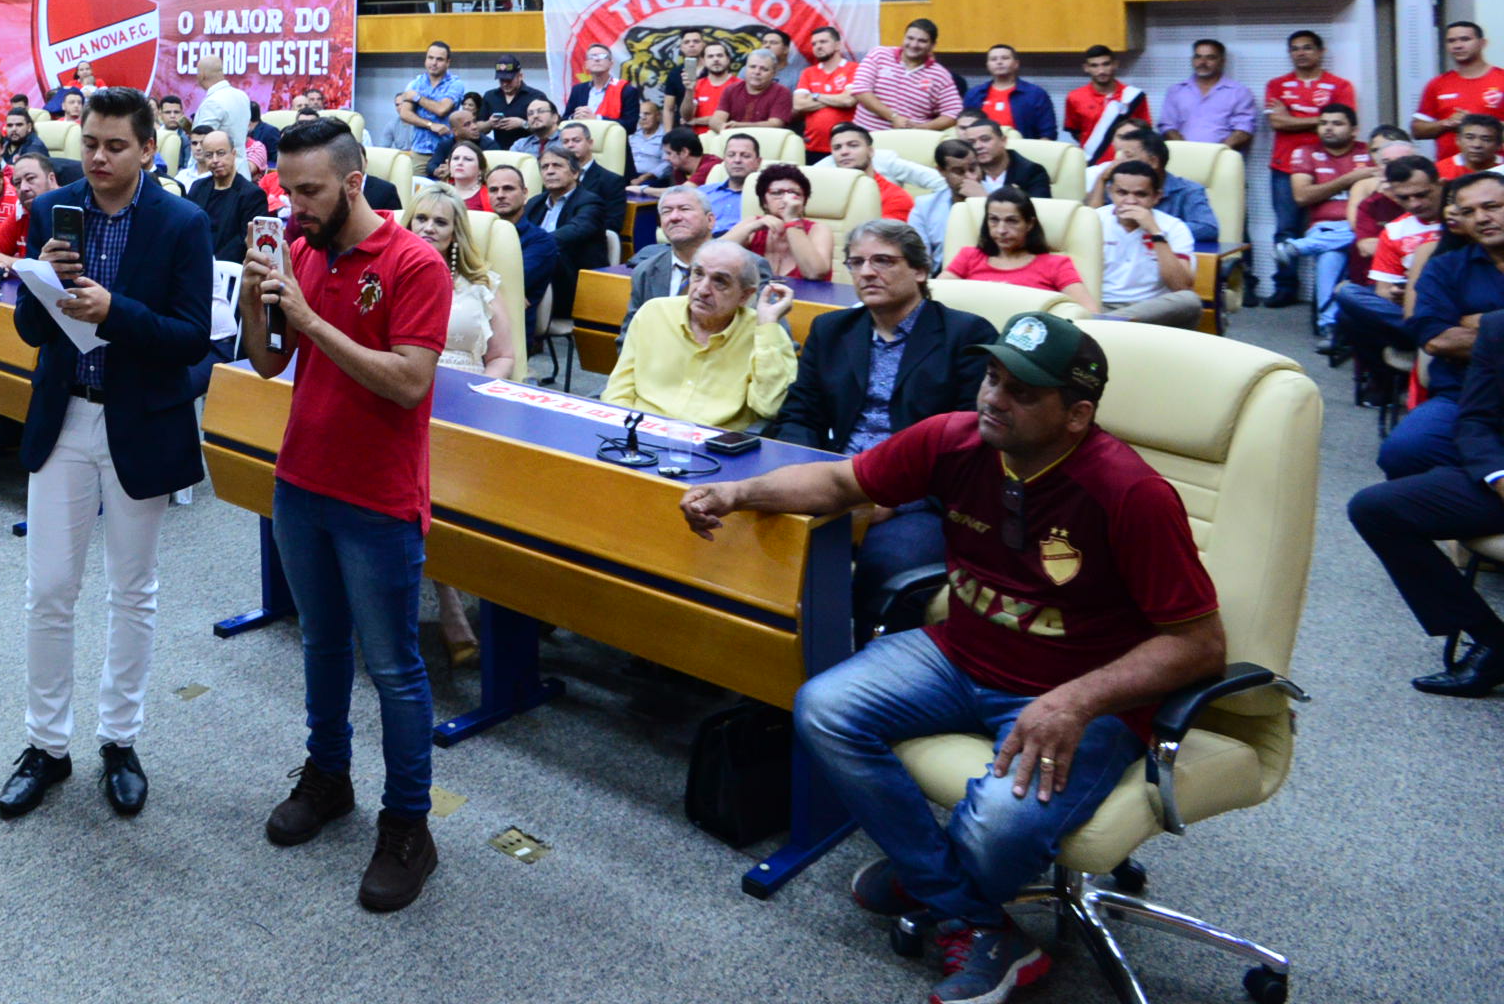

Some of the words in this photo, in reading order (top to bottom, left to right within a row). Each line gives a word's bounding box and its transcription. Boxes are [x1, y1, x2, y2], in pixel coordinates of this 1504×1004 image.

[177, 10, 194, 35] O
[203, 8, 284, 35] MAIOR
[294, 6, 331, 34] DO
[55, 43, 90, 64] VILA
[90, 29, 129, 54] NOVA
[128, 22, 153, 41] F.C.
